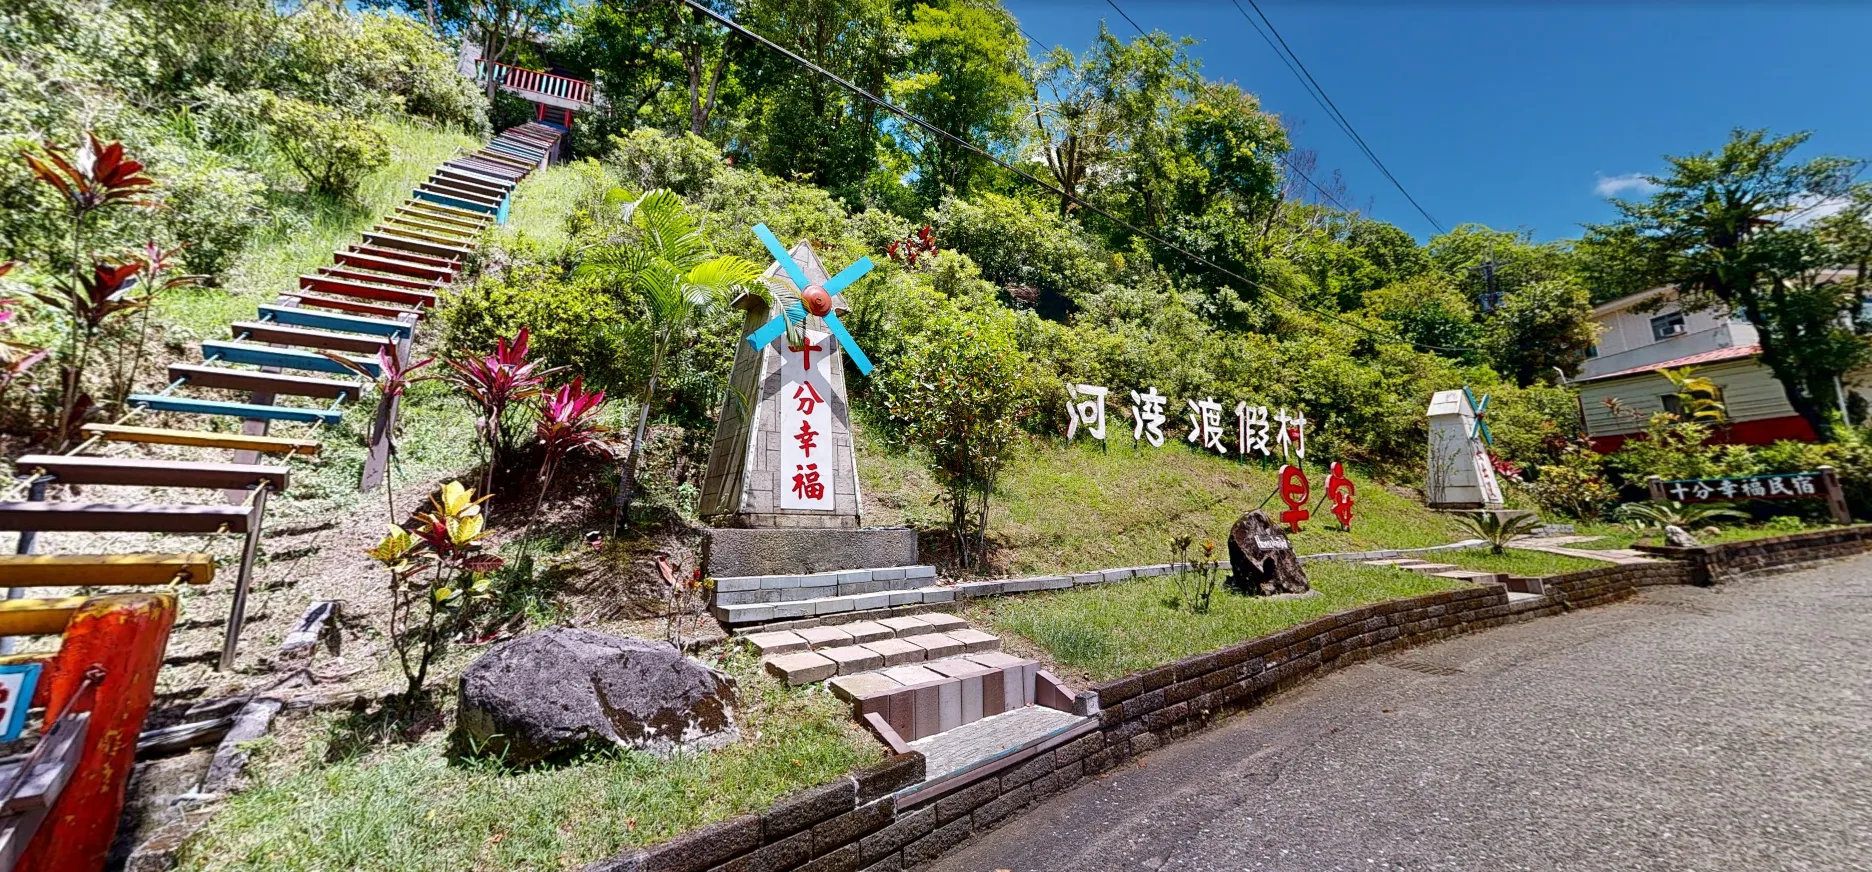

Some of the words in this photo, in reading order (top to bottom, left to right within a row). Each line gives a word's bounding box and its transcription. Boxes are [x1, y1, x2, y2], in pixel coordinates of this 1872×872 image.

[788, 337, 825, 500] 十分幸福
[1670, 475, 1816, 500] 十分幸福民宿
